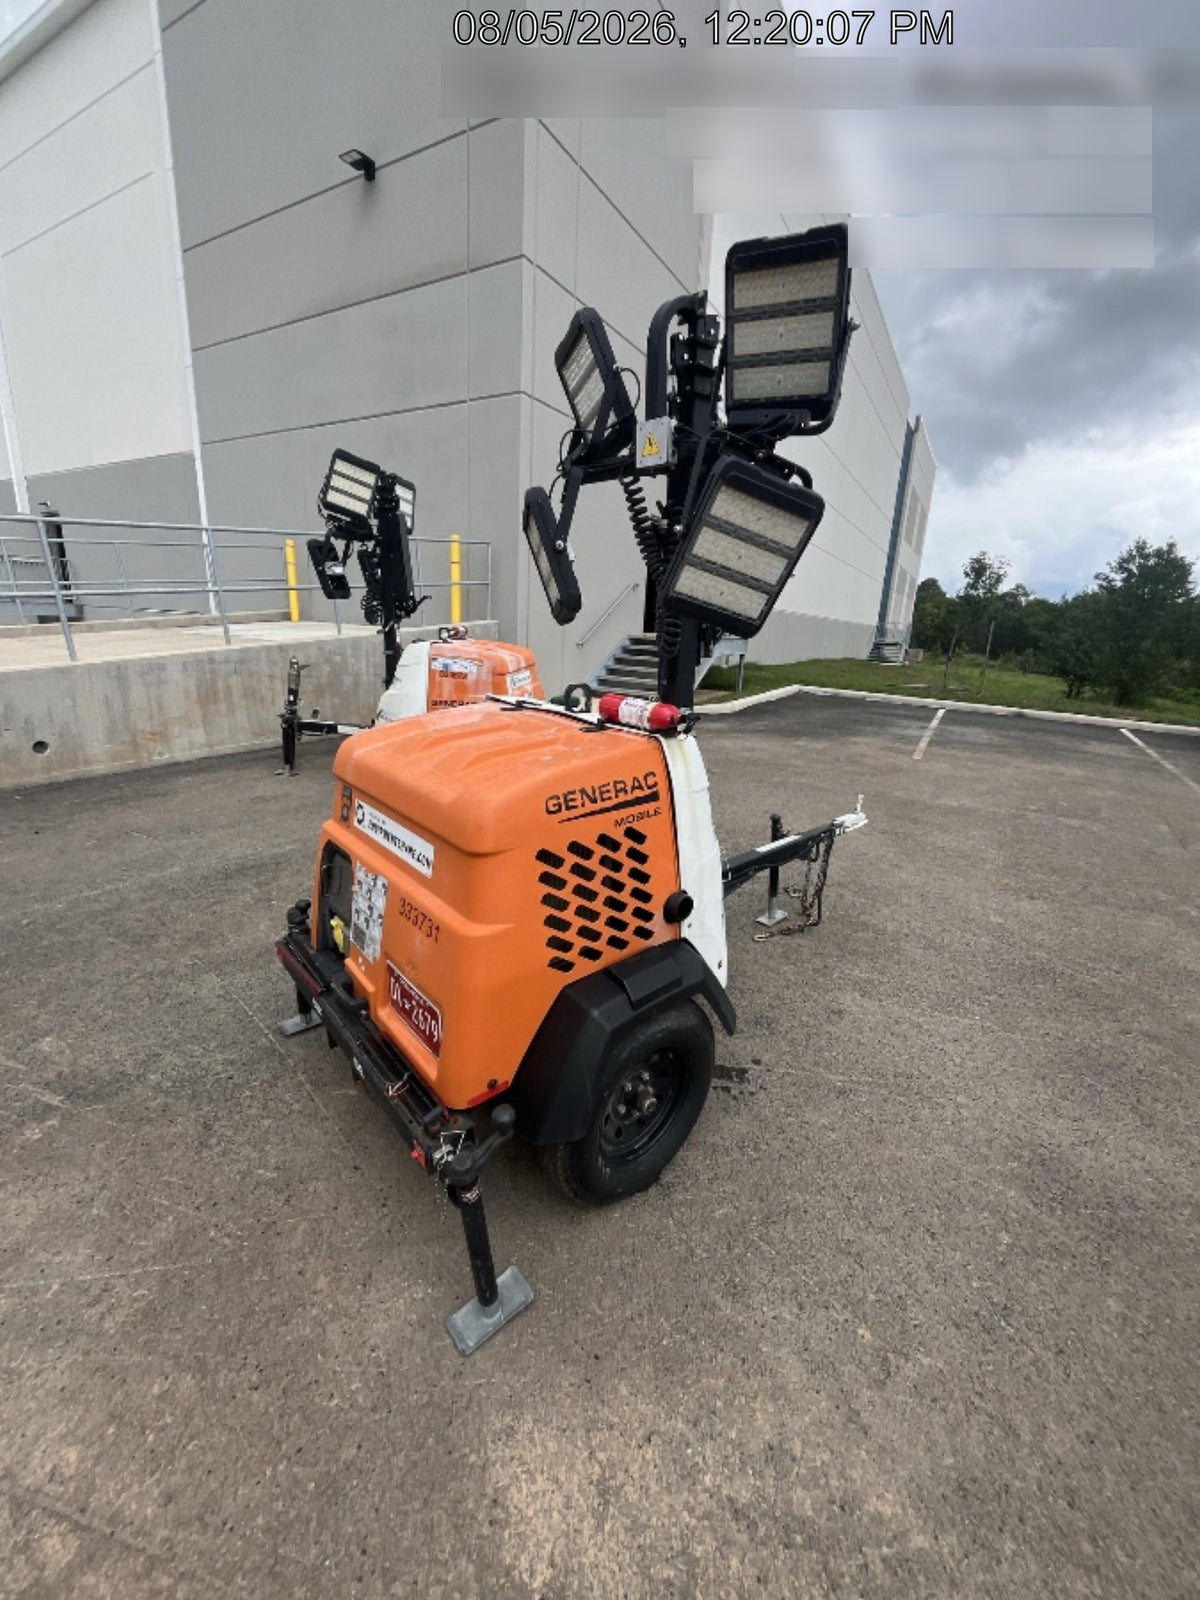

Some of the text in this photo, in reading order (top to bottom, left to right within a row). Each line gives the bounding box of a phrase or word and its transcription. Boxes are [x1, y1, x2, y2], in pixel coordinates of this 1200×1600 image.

[545, 771, 658, 815] GENERAC
[614, 807, 662, 828] MOBILE
[398, 897, 440, 943] 333731
